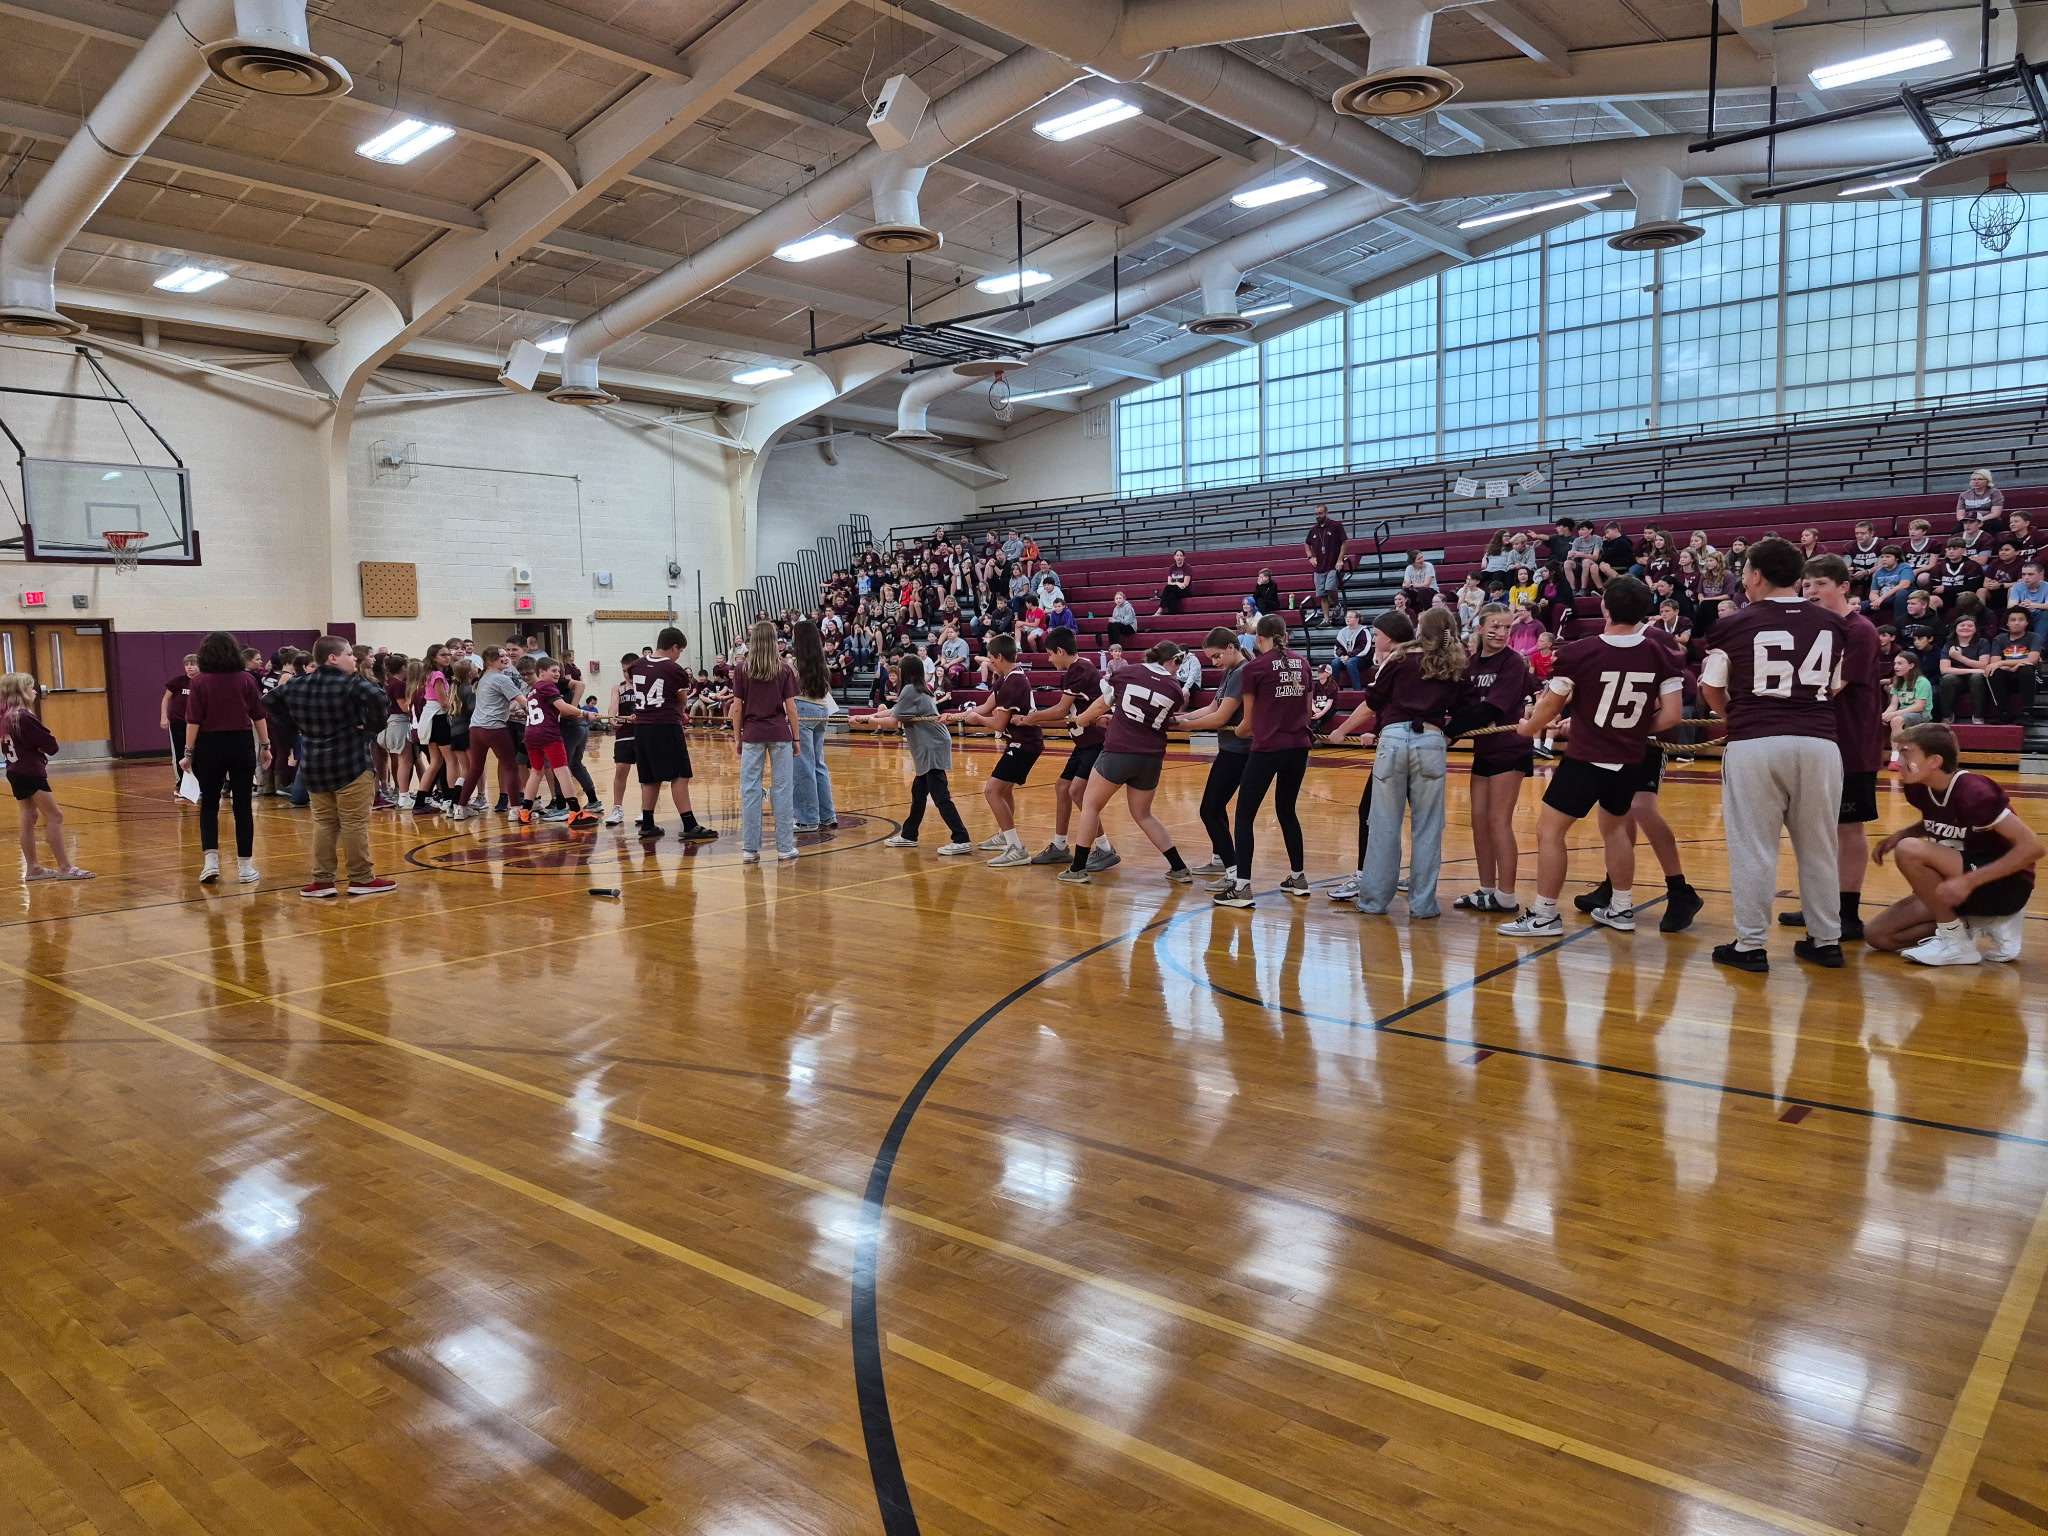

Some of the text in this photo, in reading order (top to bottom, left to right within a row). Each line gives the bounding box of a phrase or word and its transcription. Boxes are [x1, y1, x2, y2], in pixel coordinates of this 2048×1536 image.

[25, 592, 45, 604] EXIT
[1752, 630, 1833, 701] 64
[633, 674, 665, 710] 54
[1121, 683, 1175, 731] 57
[1594, 671, 1656, 728] 15
